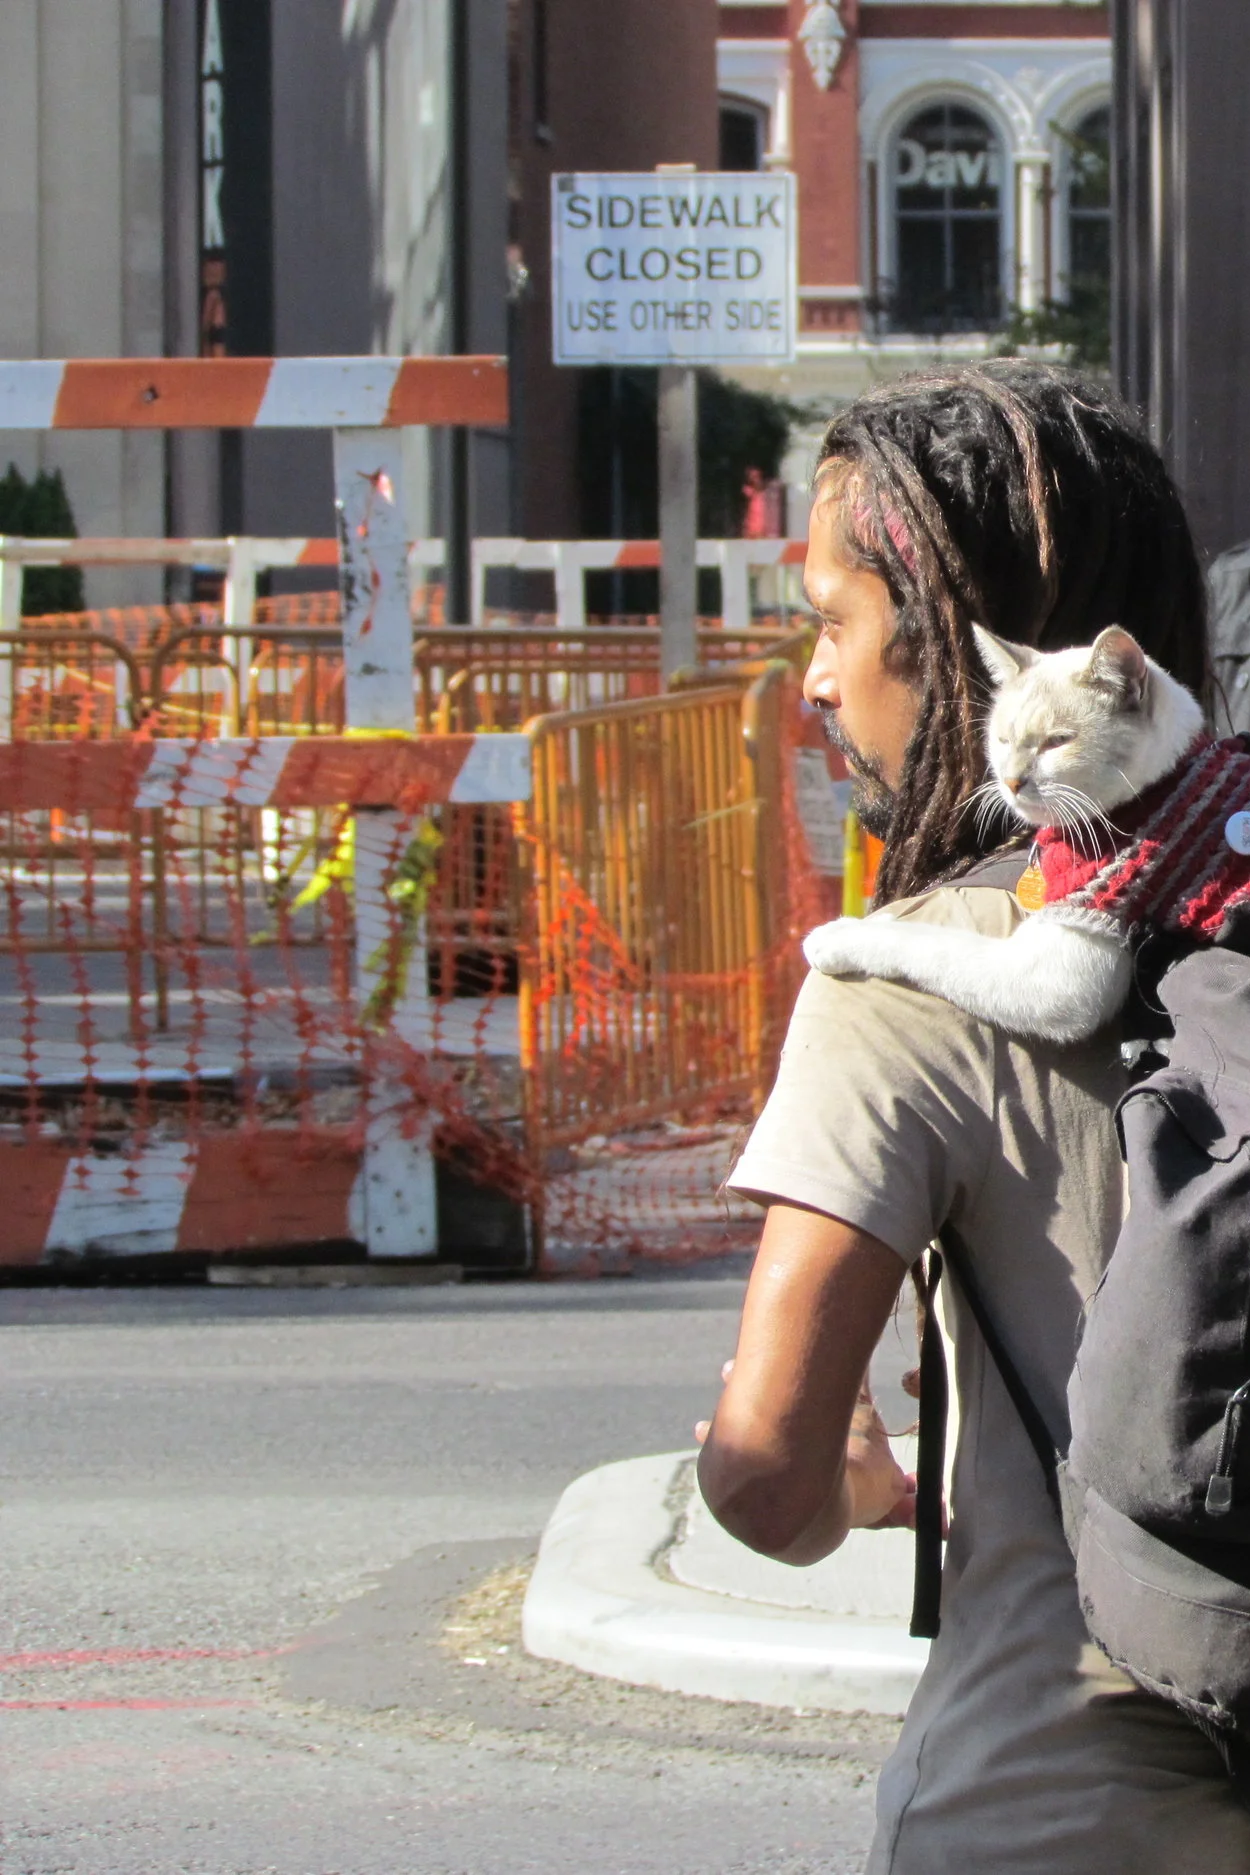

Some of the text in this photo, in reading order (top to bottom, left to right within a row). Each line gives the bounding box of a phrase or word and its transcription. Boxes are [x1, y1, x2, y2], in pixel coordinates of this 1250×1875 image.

[566, 194, 781, 229] SIDEWALK
[585, 246, 762, 281] CLOSED
[568, 299, 781, 331] USE OTHER SIDE
